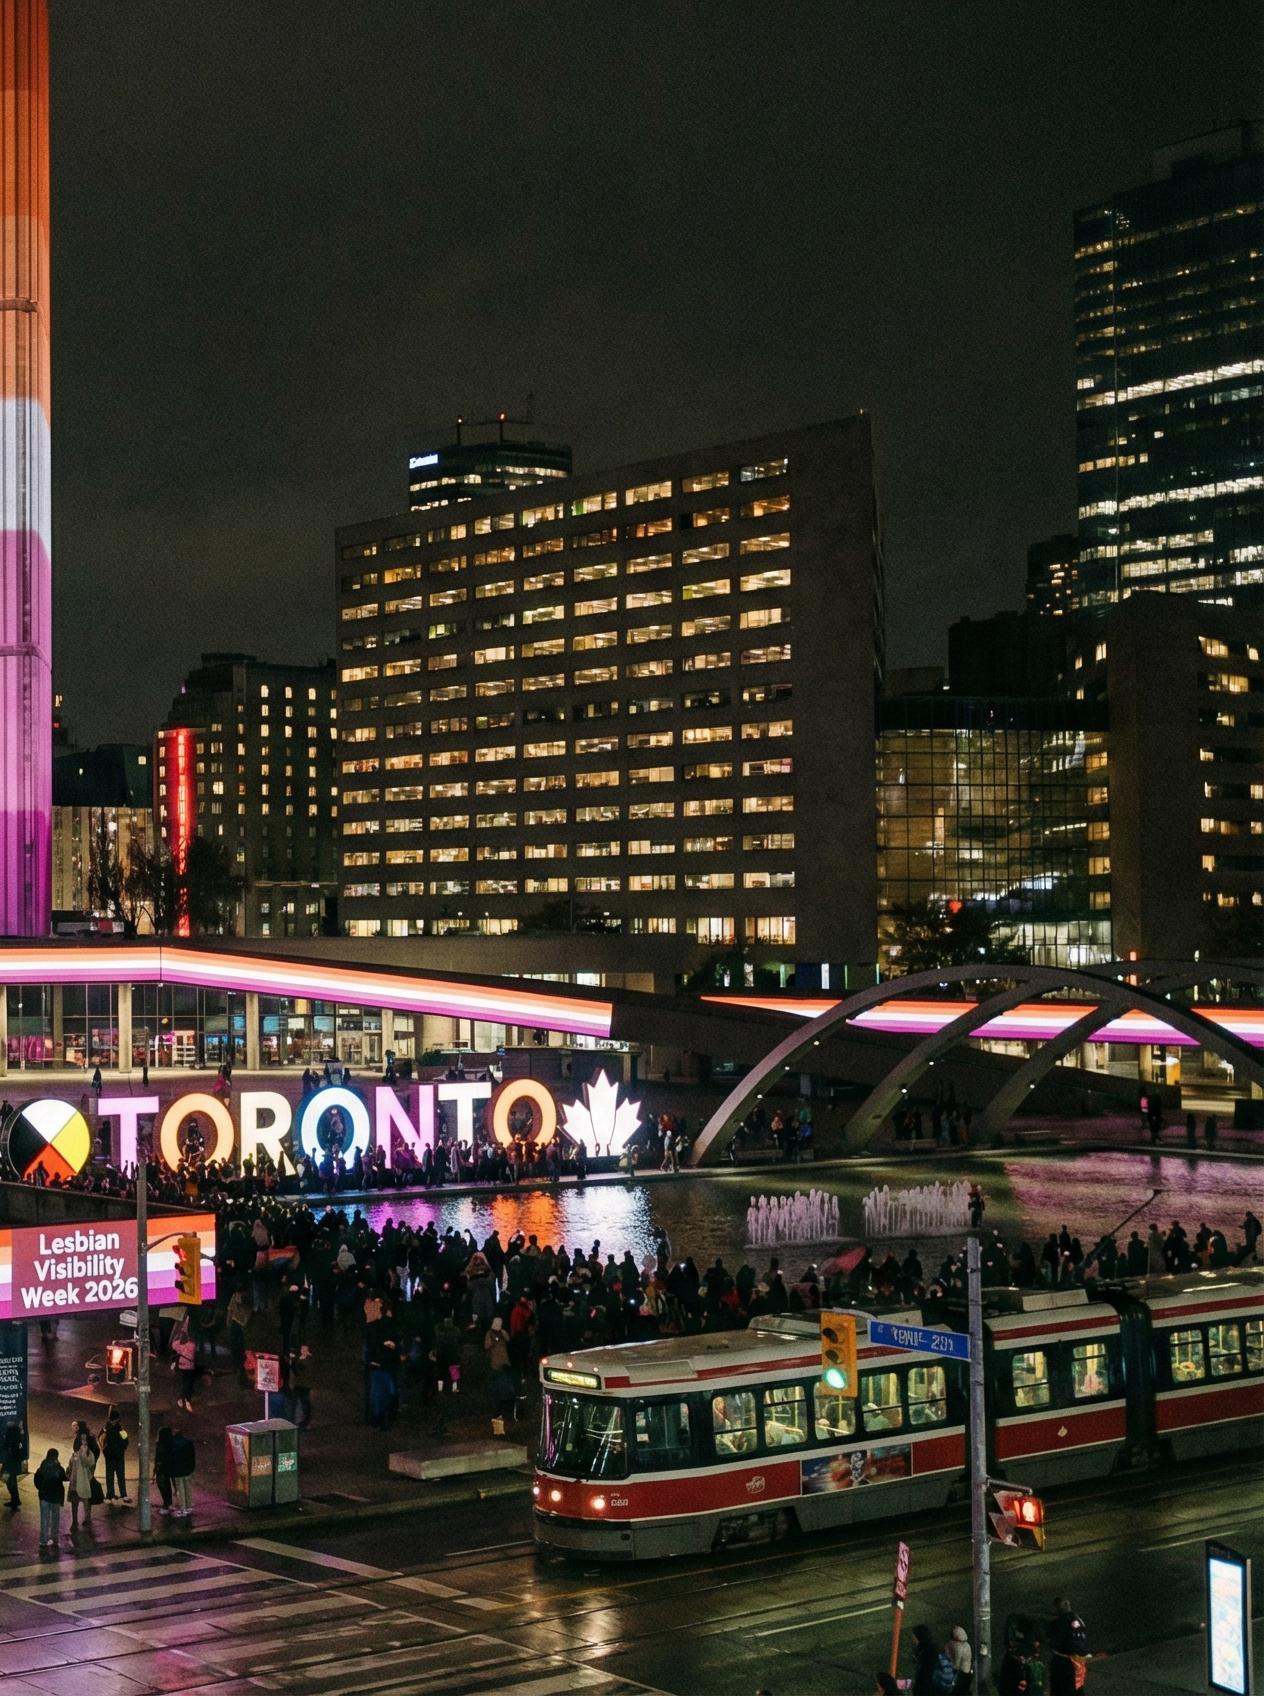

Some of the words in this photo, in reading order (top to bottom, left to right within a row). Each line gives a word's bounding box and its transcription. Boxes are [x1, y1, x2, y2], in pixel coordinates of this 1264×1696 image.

[97, 1078, 557, 1179] TORONTO
[39, 1229, 120, 1255] Lesbian
[33, 1253, 125, 1280] Visibility
[20, 1282, 80, 1309] Week
[84, 1277, 139, 1303] 2026
